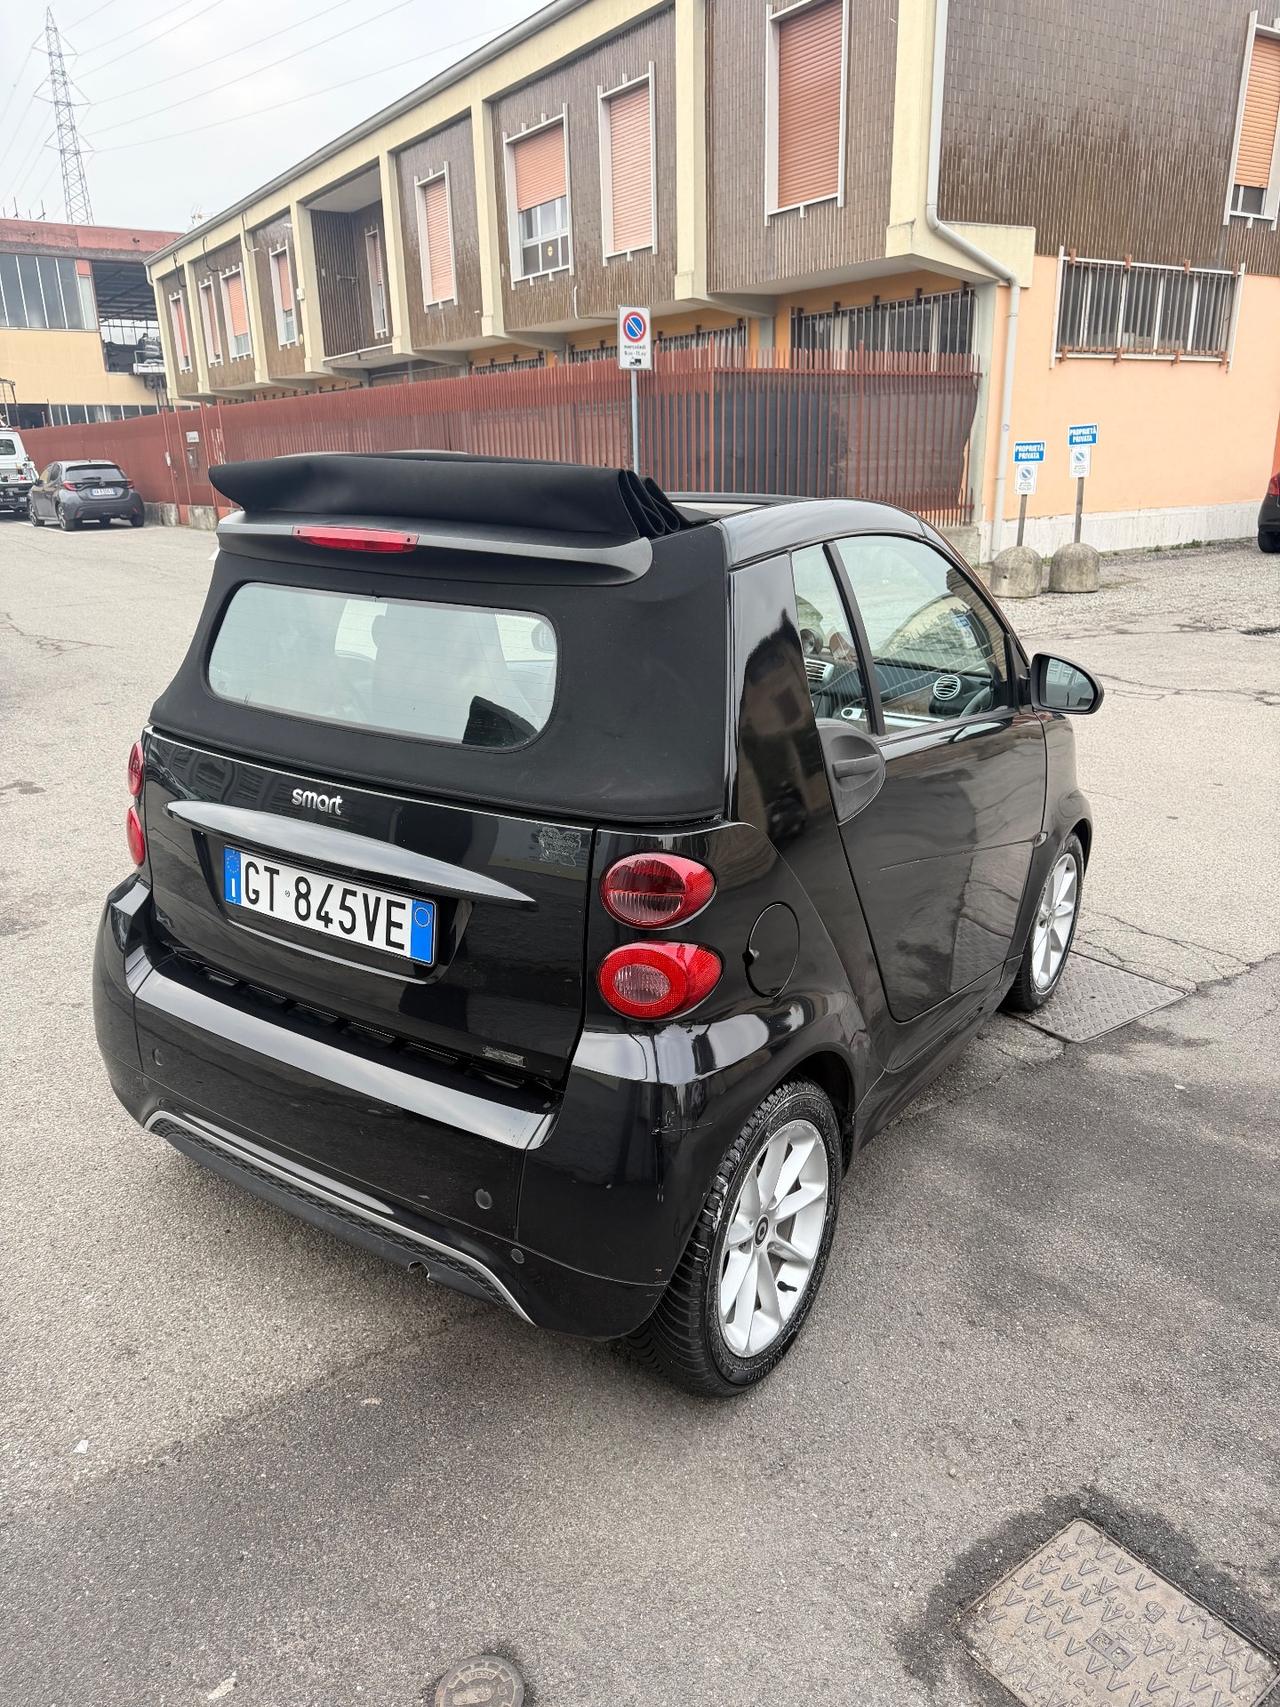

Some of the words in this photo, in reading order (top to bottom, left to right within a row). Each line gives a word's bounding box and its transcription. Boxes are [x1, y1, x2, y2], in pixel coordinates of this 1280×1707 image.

[1073, 434, 1093, 443] PRIVATA
[1018, 451, 1040, 460] PRIVATA
[291, 788, 343, 816] smart
